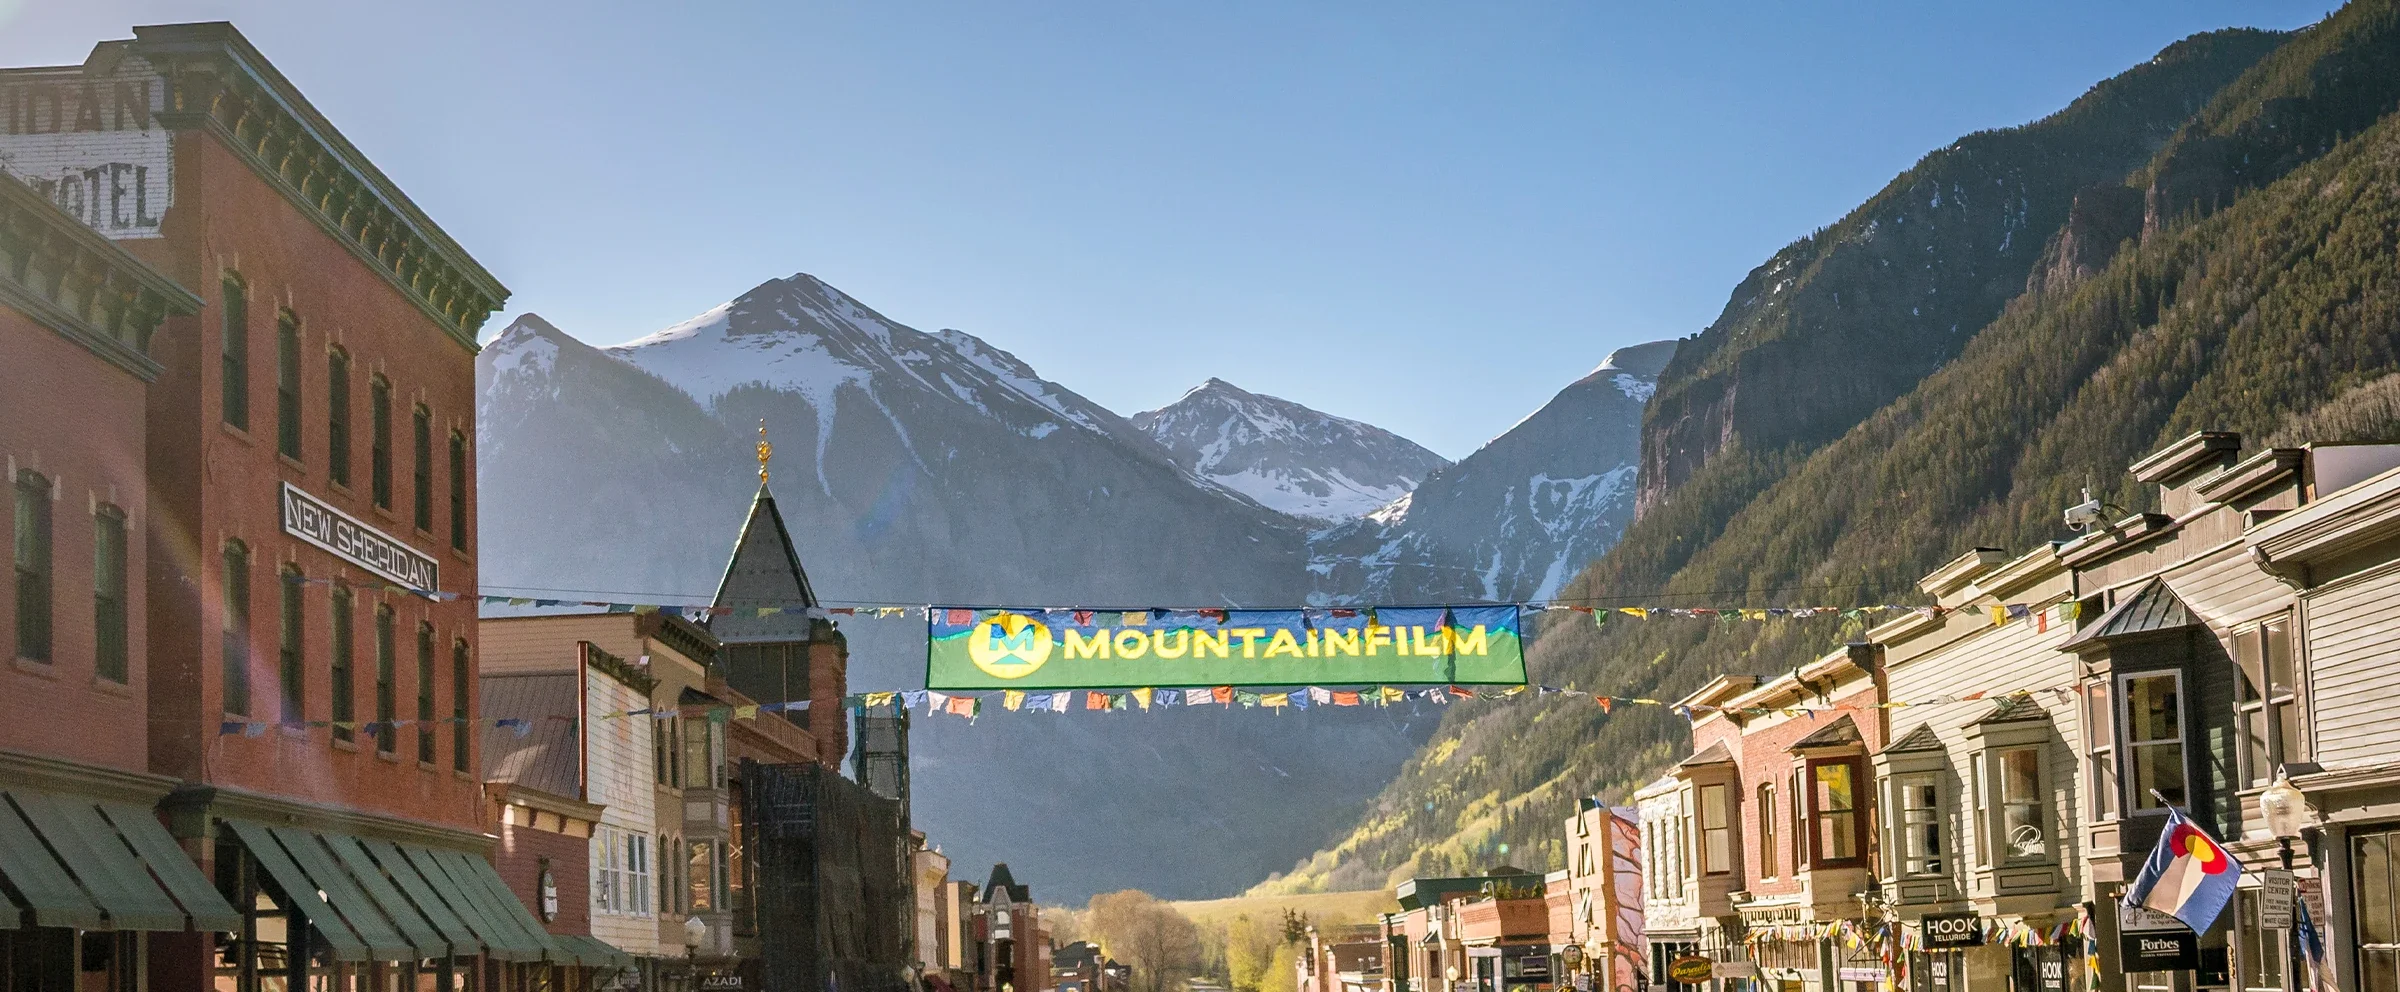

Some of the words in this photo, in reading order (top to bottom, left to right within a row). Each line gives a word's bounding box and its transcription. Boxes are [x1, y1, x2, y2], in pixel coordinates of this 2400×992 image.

[285, 493, 331, 543] NEW
[337, 520, 431, 589] SHERIDAN
[1063, 625, 1489, 659] MOUNTAINFILM
[2268, 877, 2290, 886] VISITOR
[2267, 887, 2290, 895] CENTER
[1927, 917, 1978, 934] HOOK
[1933, 933, 1971, 942] TELLURIDE
[2140, 939, 2179, 950] Forbes
[2041, 961, 2062, 978] HOOK
[703, 976, 742, 986] AZADI
